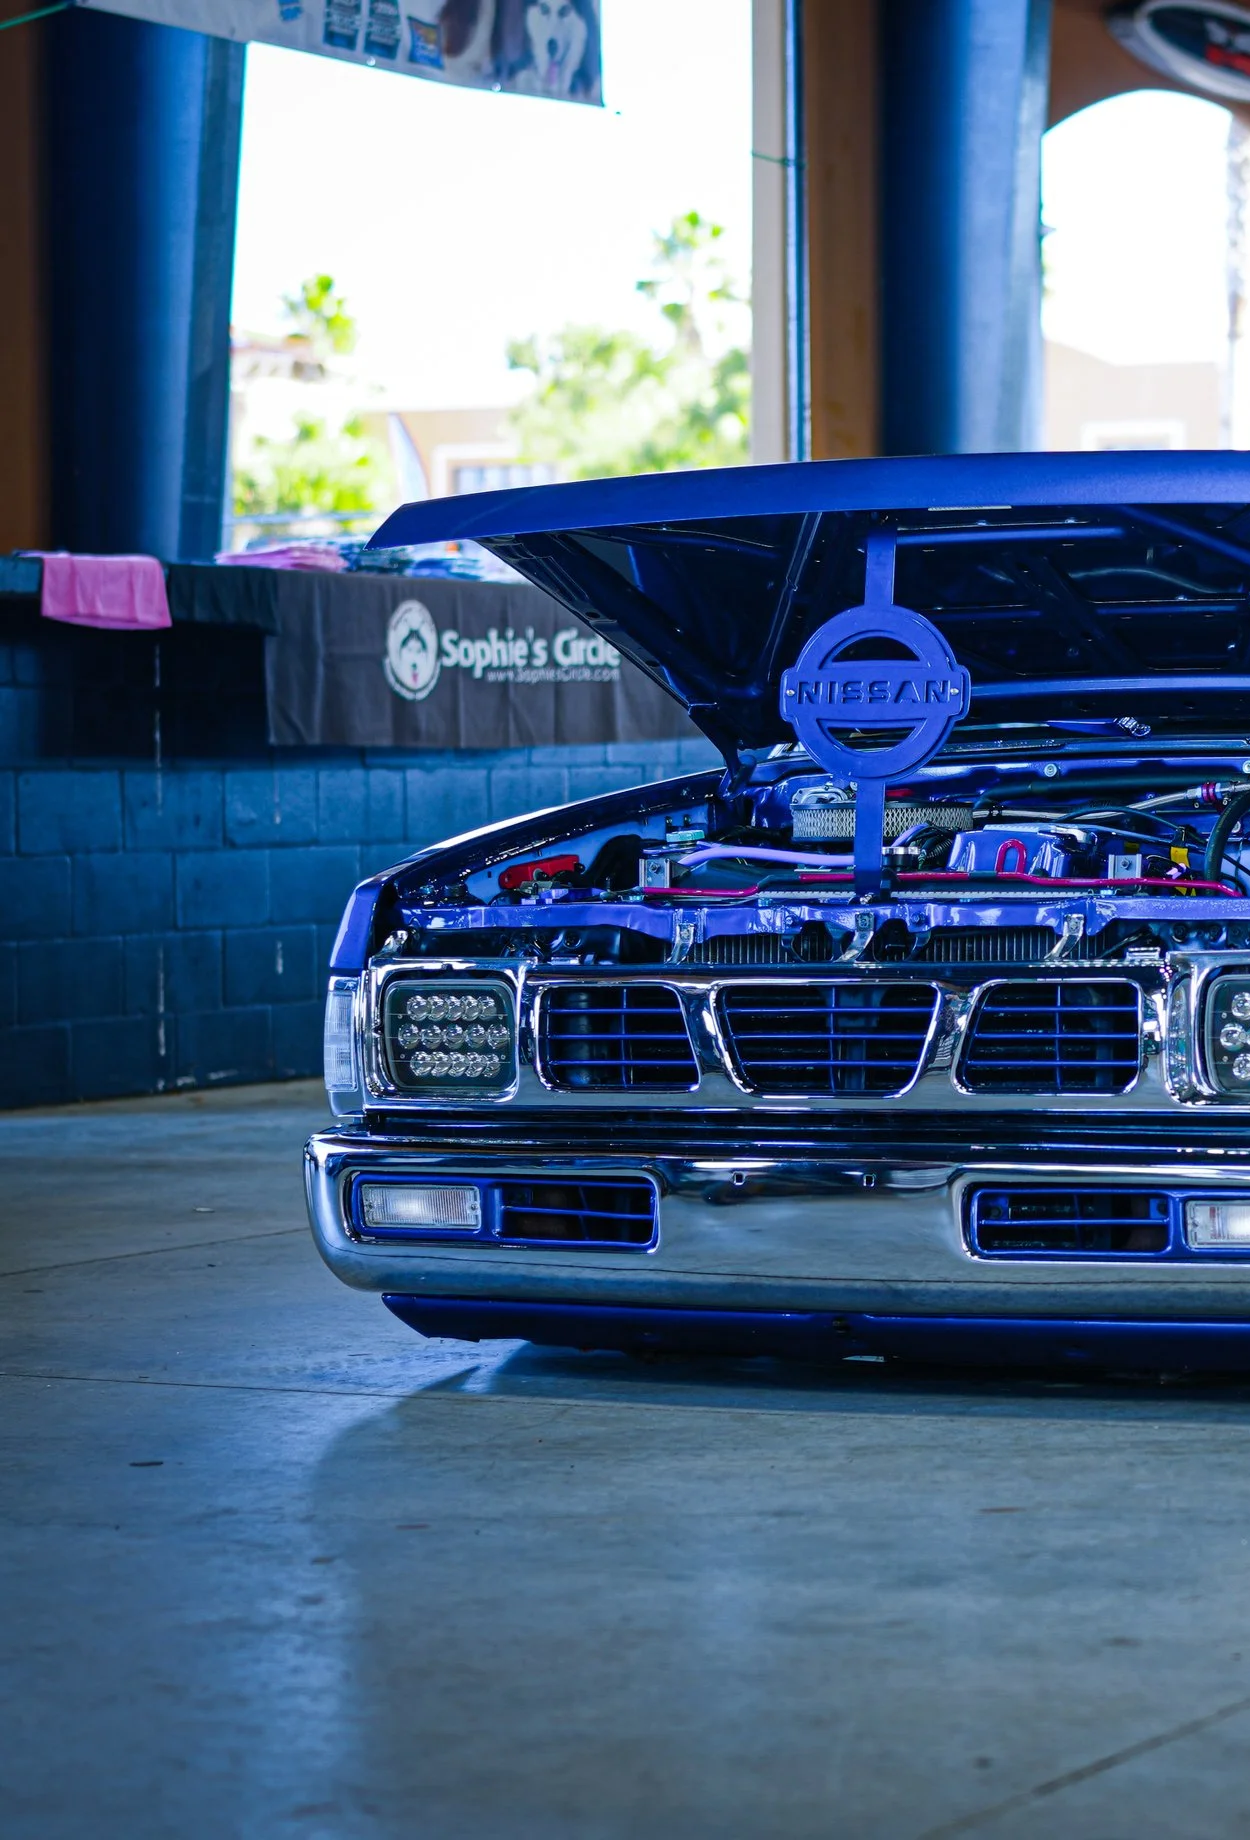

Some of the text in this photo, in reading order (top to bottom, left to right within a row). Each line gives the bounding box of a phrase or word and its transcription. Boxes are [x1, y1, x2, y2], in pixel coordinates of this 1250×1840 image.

[441, 626, 548, 678] Sophie's
[554, 627, 620, 667] Circle
[797, 680, 951, 704] NISSAN
